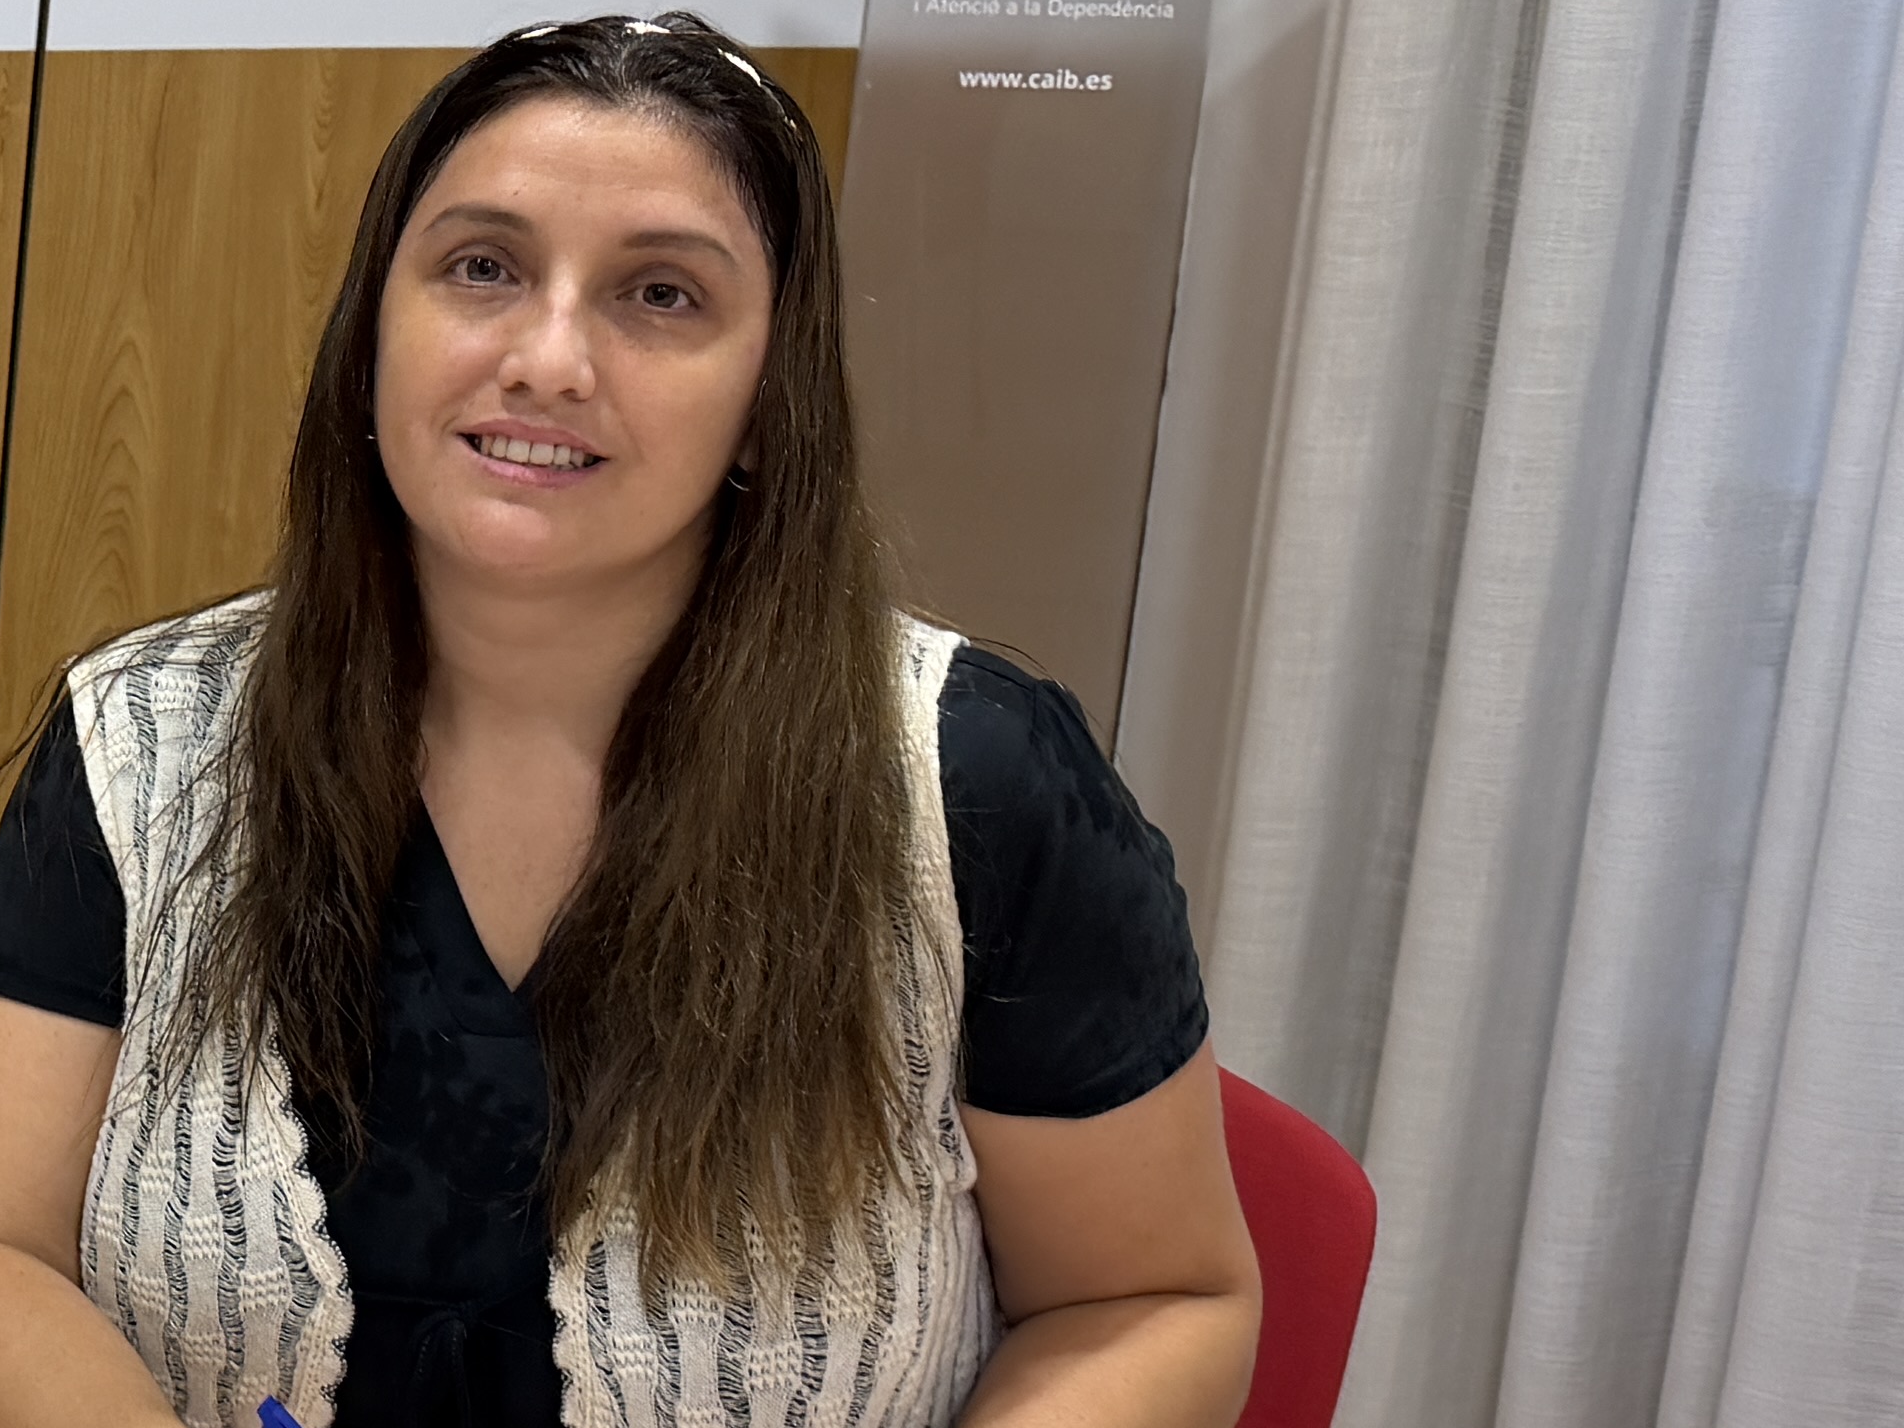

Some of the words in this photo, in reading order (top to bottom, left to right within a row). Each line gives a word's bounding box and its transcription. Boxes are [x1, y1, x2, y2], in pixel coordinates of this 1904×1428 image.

[1006, 2, 1018, 15] a
[1024, 0, 1041, 16] la
[959, 70, 1113, 90] www.caib.es
